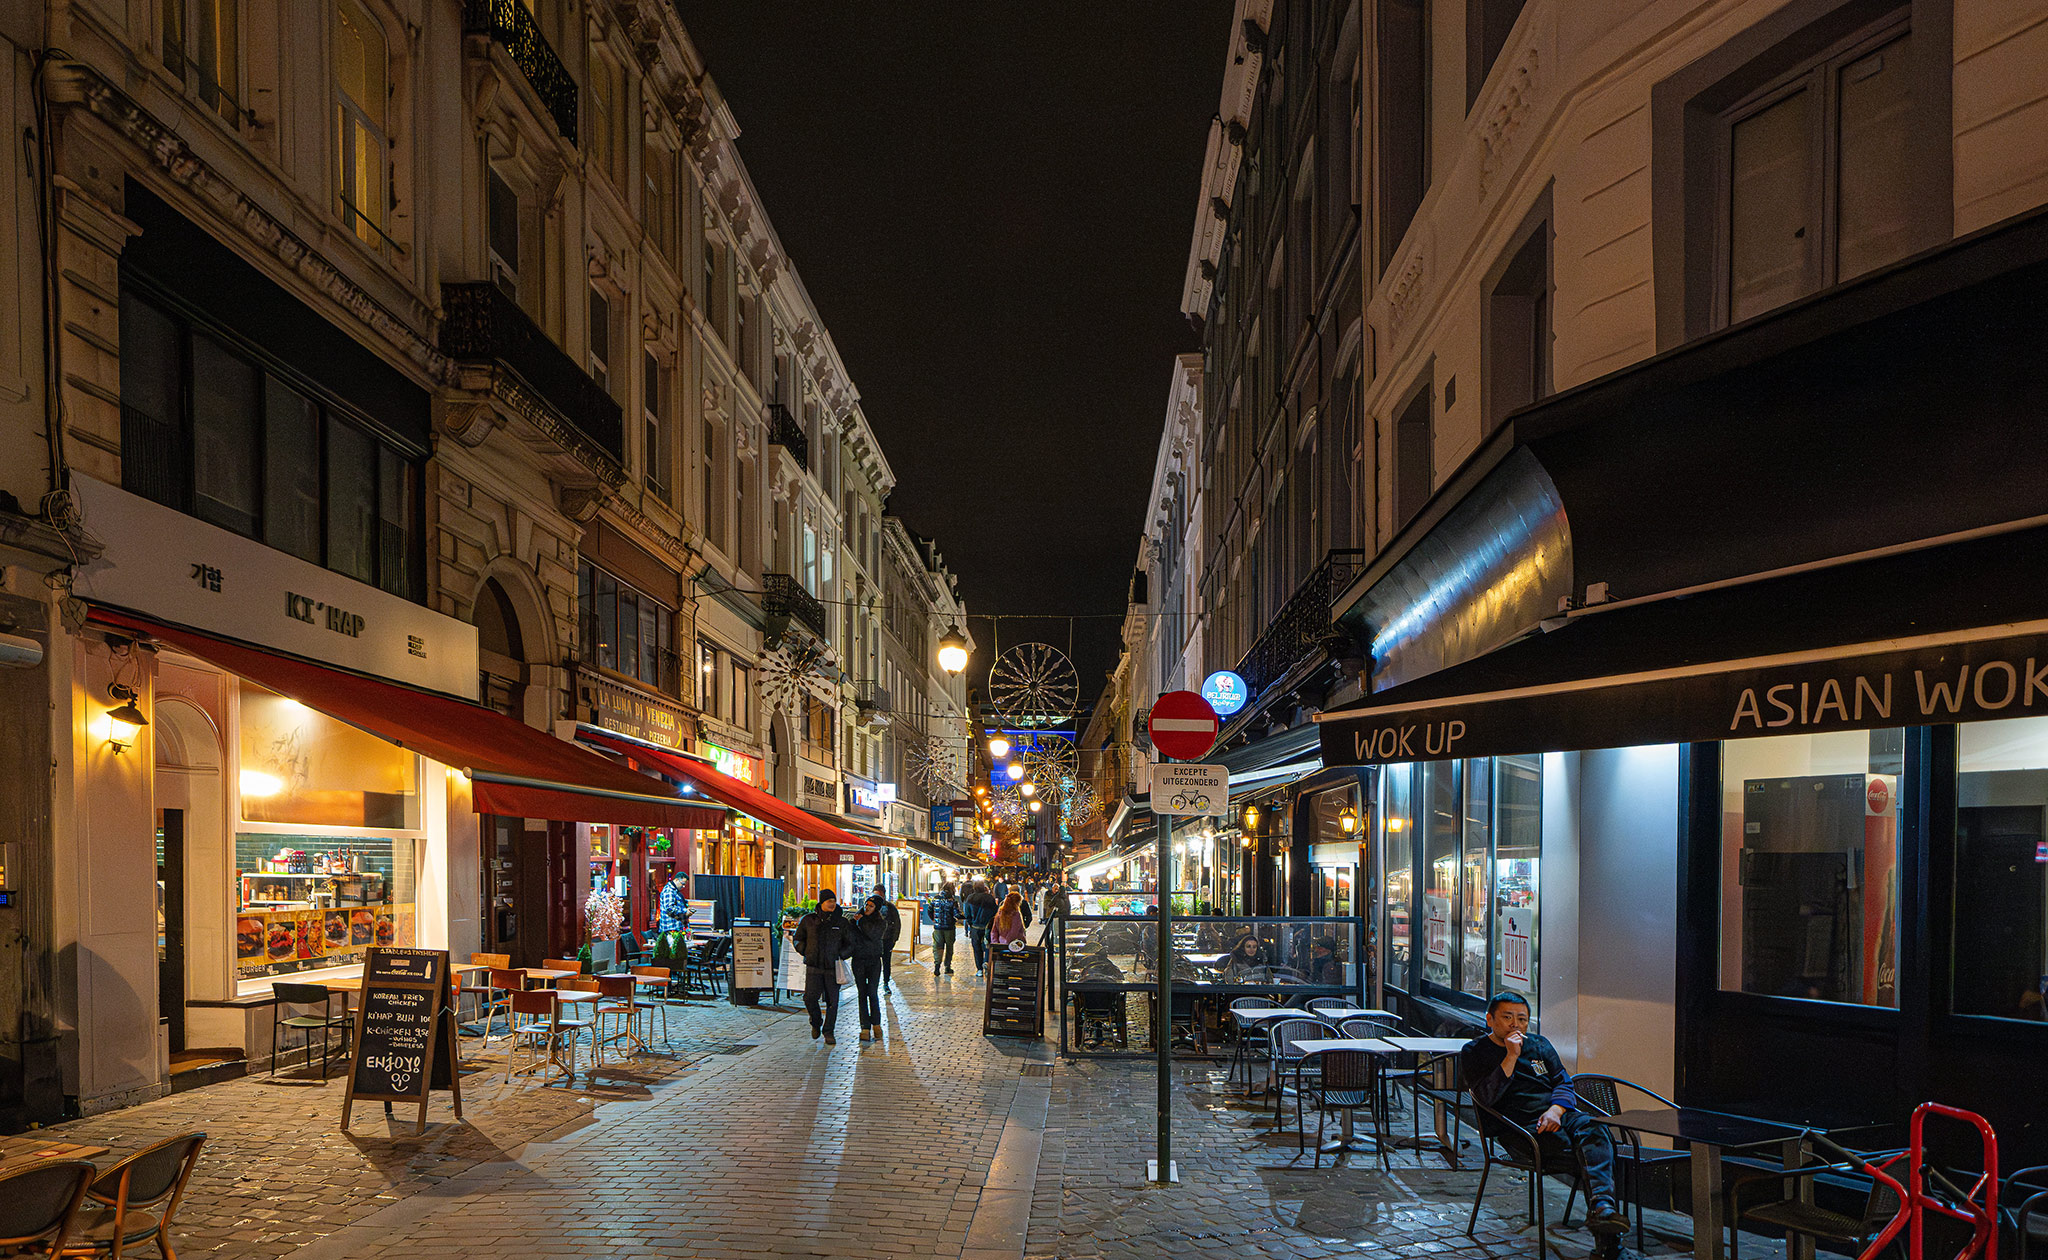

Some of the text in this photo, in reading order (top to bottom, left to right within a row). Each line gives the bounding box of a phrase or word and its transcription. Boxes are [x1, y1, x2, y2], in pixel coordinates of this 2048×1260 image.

[191, 564, 224, 593] 기합
[1730, 657, 2048, 730] ASIAN WOK
[600, 690, 675, 731] LA LUNA DI VENEZIA
[605, 718, 672, 746] RESTAURANT PIZZERIA
[1355, 720, 1466, 760] WOK UP
[1163, 777, 1219, 787] UITGEZONDERD
[1174, 768, 1208, 777] EXCEPTE
[396, 1013, 414, 1022] BUN
